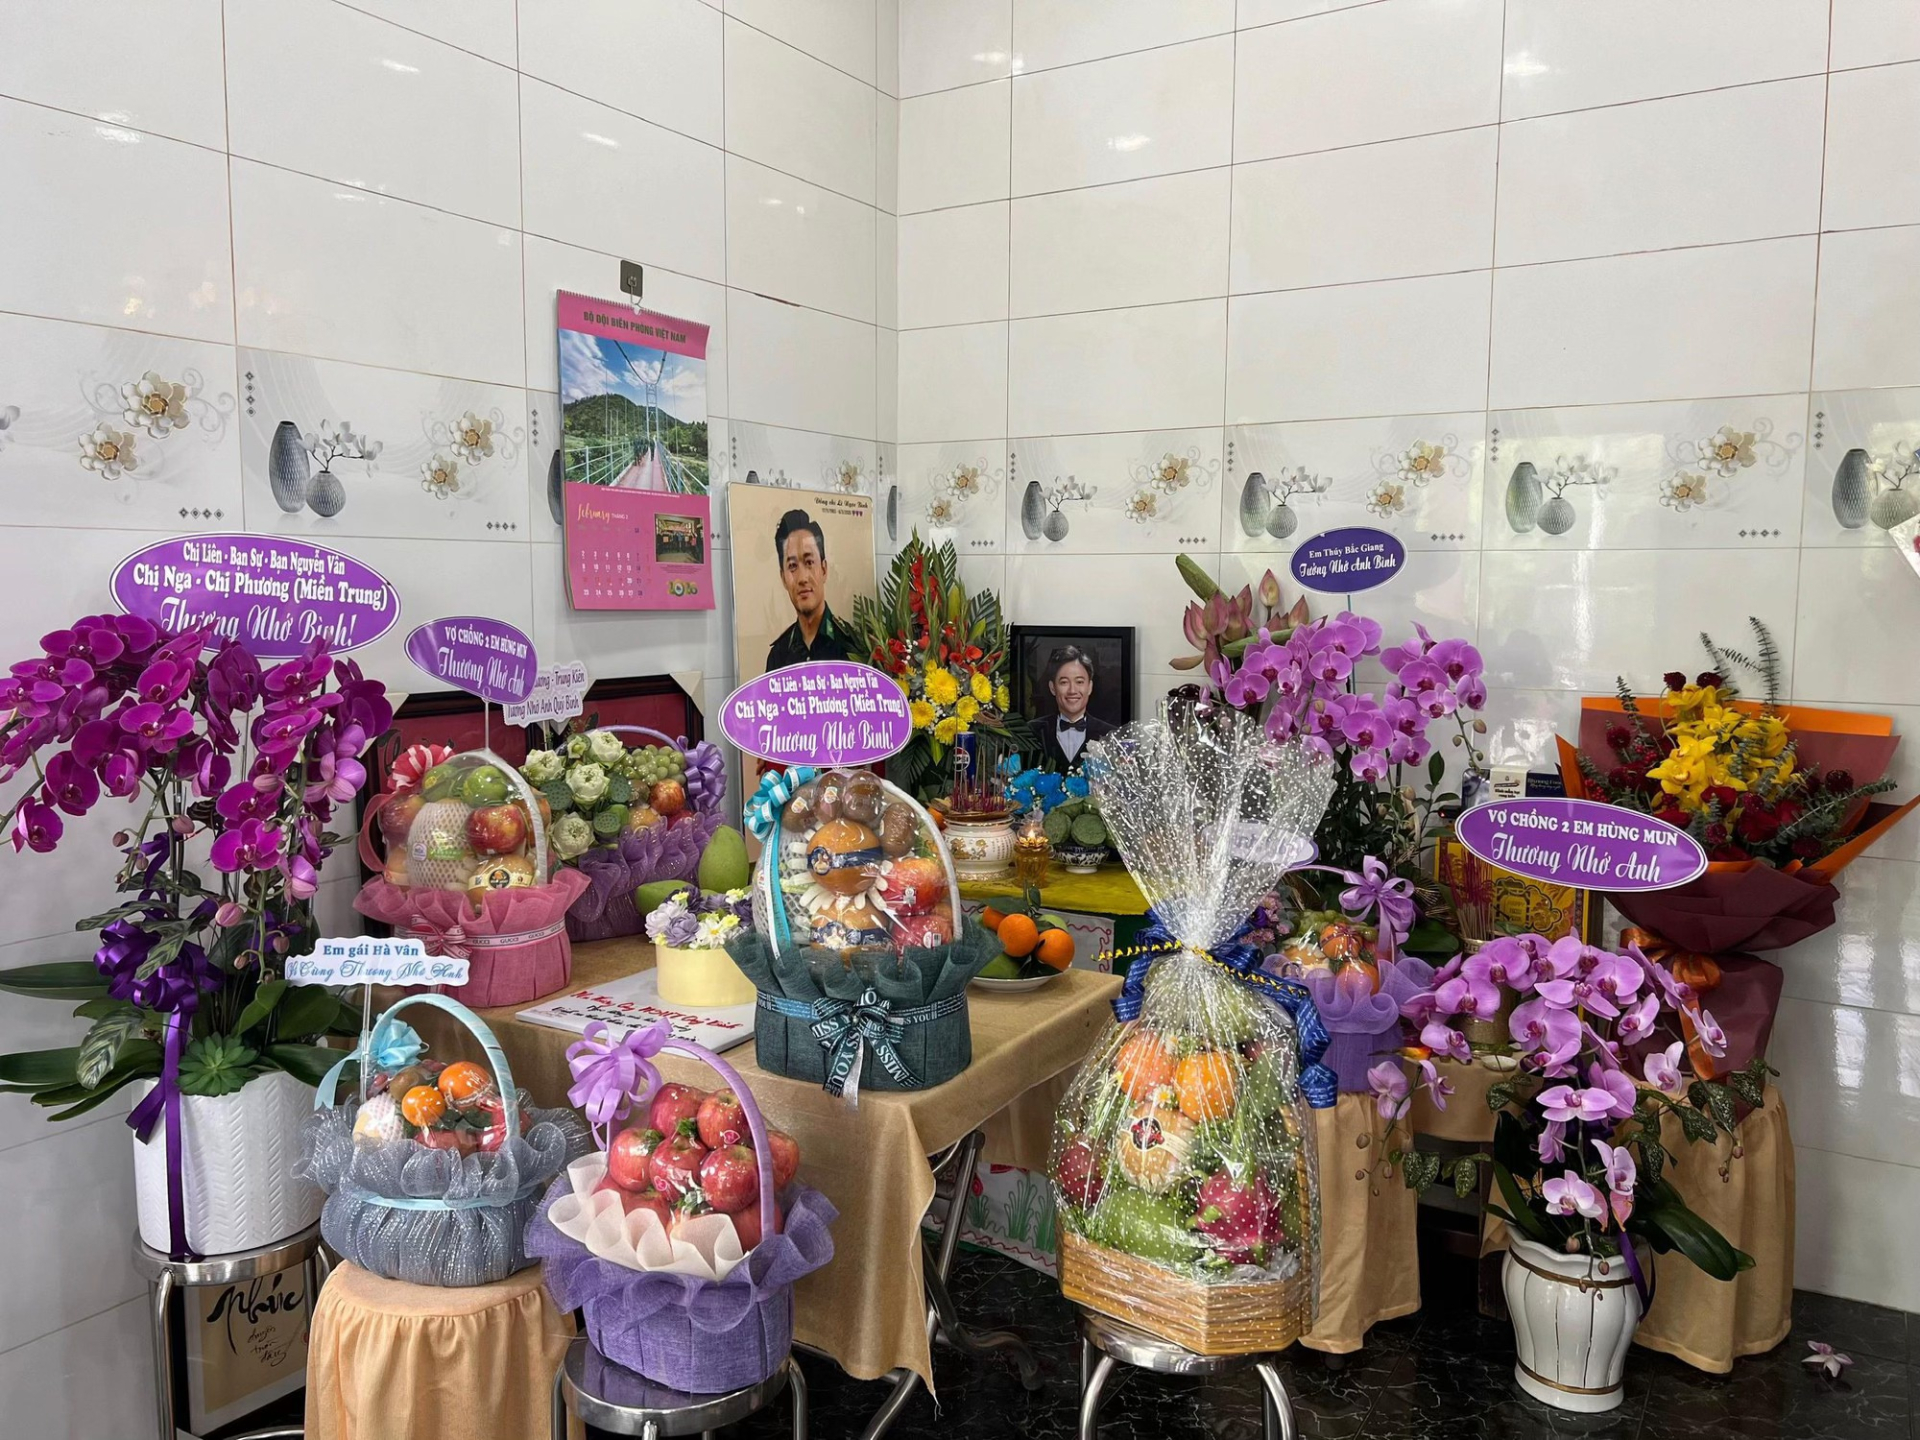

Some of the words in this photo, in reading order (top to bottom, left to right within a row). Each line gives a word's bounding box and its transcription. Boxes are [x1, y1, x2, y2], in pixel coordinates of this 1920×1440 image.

[583, 311, 594, 324] BỘ
[596, 315, 609, 327] ĐỘI
[611, 317, 629, 329] BIÊN
[630, 321, 654, 336] PHÒNG
[655, 328, 669, 340] VIỆT
[671, 331, 686, 343] NAM
[183, 541, 200, 568] Chị
[201, 544, 222, 564] Liên
[230, 546, 248, 571] Bạn
[250, 548, 263, 573] Sự
[270, 550, 288, 575] Bạn
[290, 549, 325, 577] Nguyễn
[327, 555, 346, 575] Vân
[1299, 562, 1327, 578] Tưởng
[1329, 559, 1349, 574] Nhớ
[1350, 557, 1371, 571] Anh
[1373, 553, 1396, 569] Bình
[1309, 551, 1322, 559] Em
[1323, 547, 1342, 557] Thúy
[1345, 543, 1359, 555] Bắc
[1361, 543, 1384, 552] Giang
[133, 562, 160, 593] Chị
[163, 565, 192, 593] Nga
[205, 571, 230, 598] Chị
[234, 571, 290, 602] Phương
[294, 577, 334, 604] (Miền
[338, 584, 388, 611] Trung)
[247, 604, 293, 642] Nhớ
[298, 609, 357, 646] Bình!
[445, 625, 457, 646] VỢ
[458, 624, 484, 648] CHỒNG
[485, 636, 490, 648] 2
[490, 635, 500, 651] EM
[500, 634, 516, 656] HÙNG
[516, 642, 528, 660] MUN
[438, 646, 484, 689] Thương
[487, 656, 509, 690] Nhớ
[508, 664, 525, 698] Anh
[555, 671, 571, 688] Trung
[768, 677, 782, 697] Chị
[782, 676, 798, 693] Liên
[801, 675, 815, 695] Bạn
[816, 674, 827, 694] Sự
[829, 673, 844, 694] Bạn
[843, 669, 867, 692] Nguyễn
[866, 671, 879, 689] Vân
[541, 699, 553, 713] Anh
[735, 699, 755, 723] Chị
[756, 700, 779, 721] Nga
[787, 696, 807, 719] Chị
[809, 696, 848, 717] Phương
[850, 691, 877, 717] (Miền
[877, 694, 905, 717] Trung)
[758, 724, 819, 758] Thương
[822, 721, 856, 752] Nhớ
[858, 720, 894, 750] Bình!
[1487, 808, 1508, 828] VỢ
[1510, 807, 1558, 831] CHỒNG
[1561, 821, 1570, 833] 2
[1574, 820, 1594, 836] EM
[1597, 820, 1639, 842] HÙNG
[1643, 828, 1679, 847] MUN
[1490, 832, 1562, 874] Thương
[1567, 843, 1612, 875] Nhớ
[1615, 851, 1661, 884] Anh
[323, 945, 345, 955] Em
[348, 943, 369, 959] gái
[372, 943, 391, 955] Hà
[394, 944, 419, 956] Vân
[298, 961, 335, 982] Cùng
[340, 960, 393, 982] Thương
[425, 963, 463, 981] Anh
[913, 1012, 931, 1024] YOU
[831, 1051, 854, 1087] YOU
[876, 1045, 907, 1082] MISS
